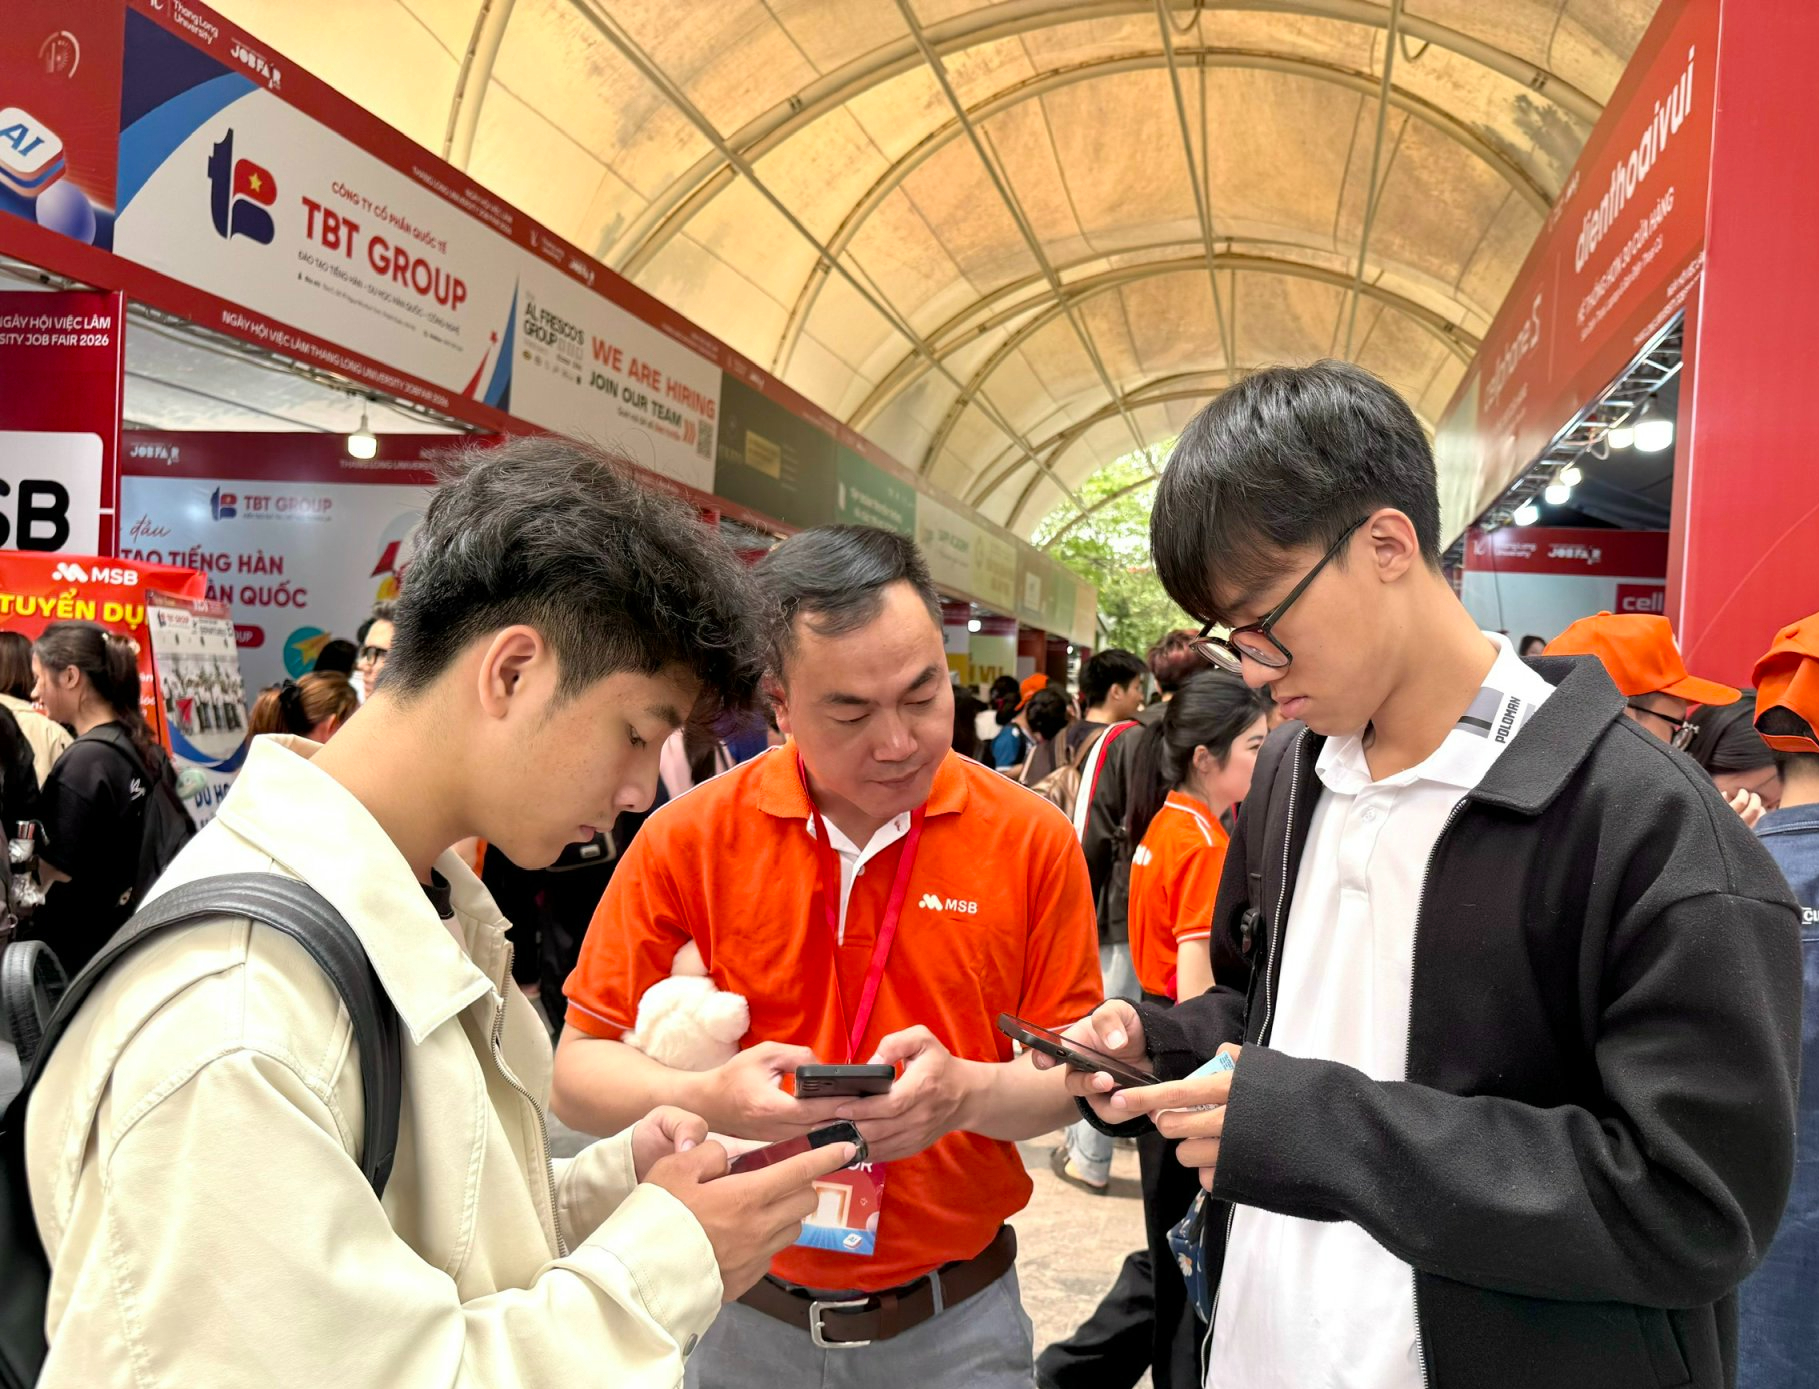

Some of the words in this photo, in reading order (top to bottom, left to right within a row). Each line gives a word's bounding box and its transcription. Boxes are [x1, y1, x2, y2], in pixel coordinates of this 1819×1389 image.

[174, 11, 214, 45] University
[0, 123, 45, 157] AI
[302, 195, 361, 260] TBT
[368, 235, 468, 311] GROUP
[0, 313, 28, 328] GÀY
[29, 314, 52, 331] HỘI
[55, 314, 82, 332] VIỆC
[84, 313, 111, 329] LÀM
[25, 334, 49, 346] JOB
[51, 334, 77, 346] FAIR
[79, 334, 110, 346] 2026
[592, 336, 623, 372] WE
[628, 357, 662, 392] ARE
[666, 377, 715, 421] HIRING
[590, 371, 619, 398] JOIN
[622, 387, 648, 412] OUR
[651, 400, 682, 427] TEAM
[0, 478, 69, 552] B
[244, 496, 271, 511] TBT
[276, 497, 333, 513] GROUP
[92, 566, 139, 586] MSB
[238, 549, 284, 575] HÀN
[0, 587, 96, 620] TUYỂN
[103, 601, 149, 631] DỤ
[204, 579, 234, 605] ÀN
[240, 580, 307, 608] QUỐC
[1495, 696, 1521, 744] POLOMAN
[945, 898, 977, 914] MSB
